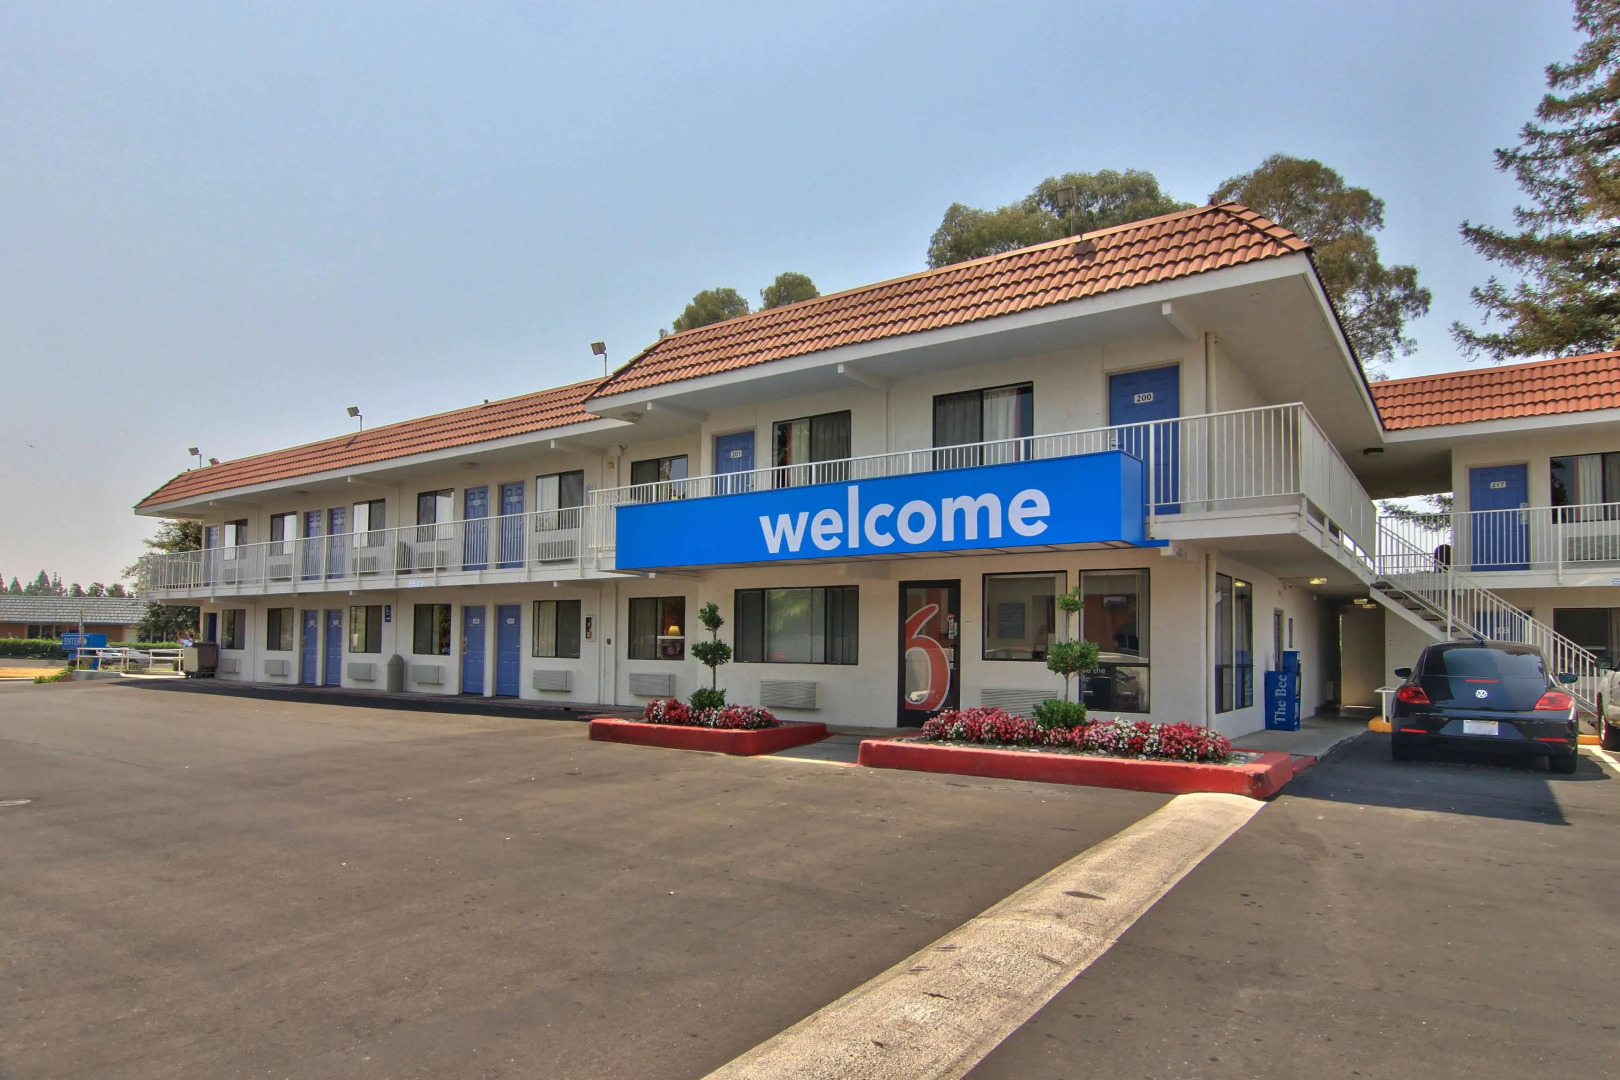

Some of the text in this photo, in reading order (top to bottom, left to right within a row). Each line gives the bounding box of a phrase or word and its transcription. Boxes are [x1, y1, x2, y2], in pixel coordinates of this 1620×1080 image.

[1135, 393, 1152, 403] 200
[758, 485, 1050, 554] welcome
[905, 603, 951, 711] 6
[1273, 674, 1288, 724] The Bee
